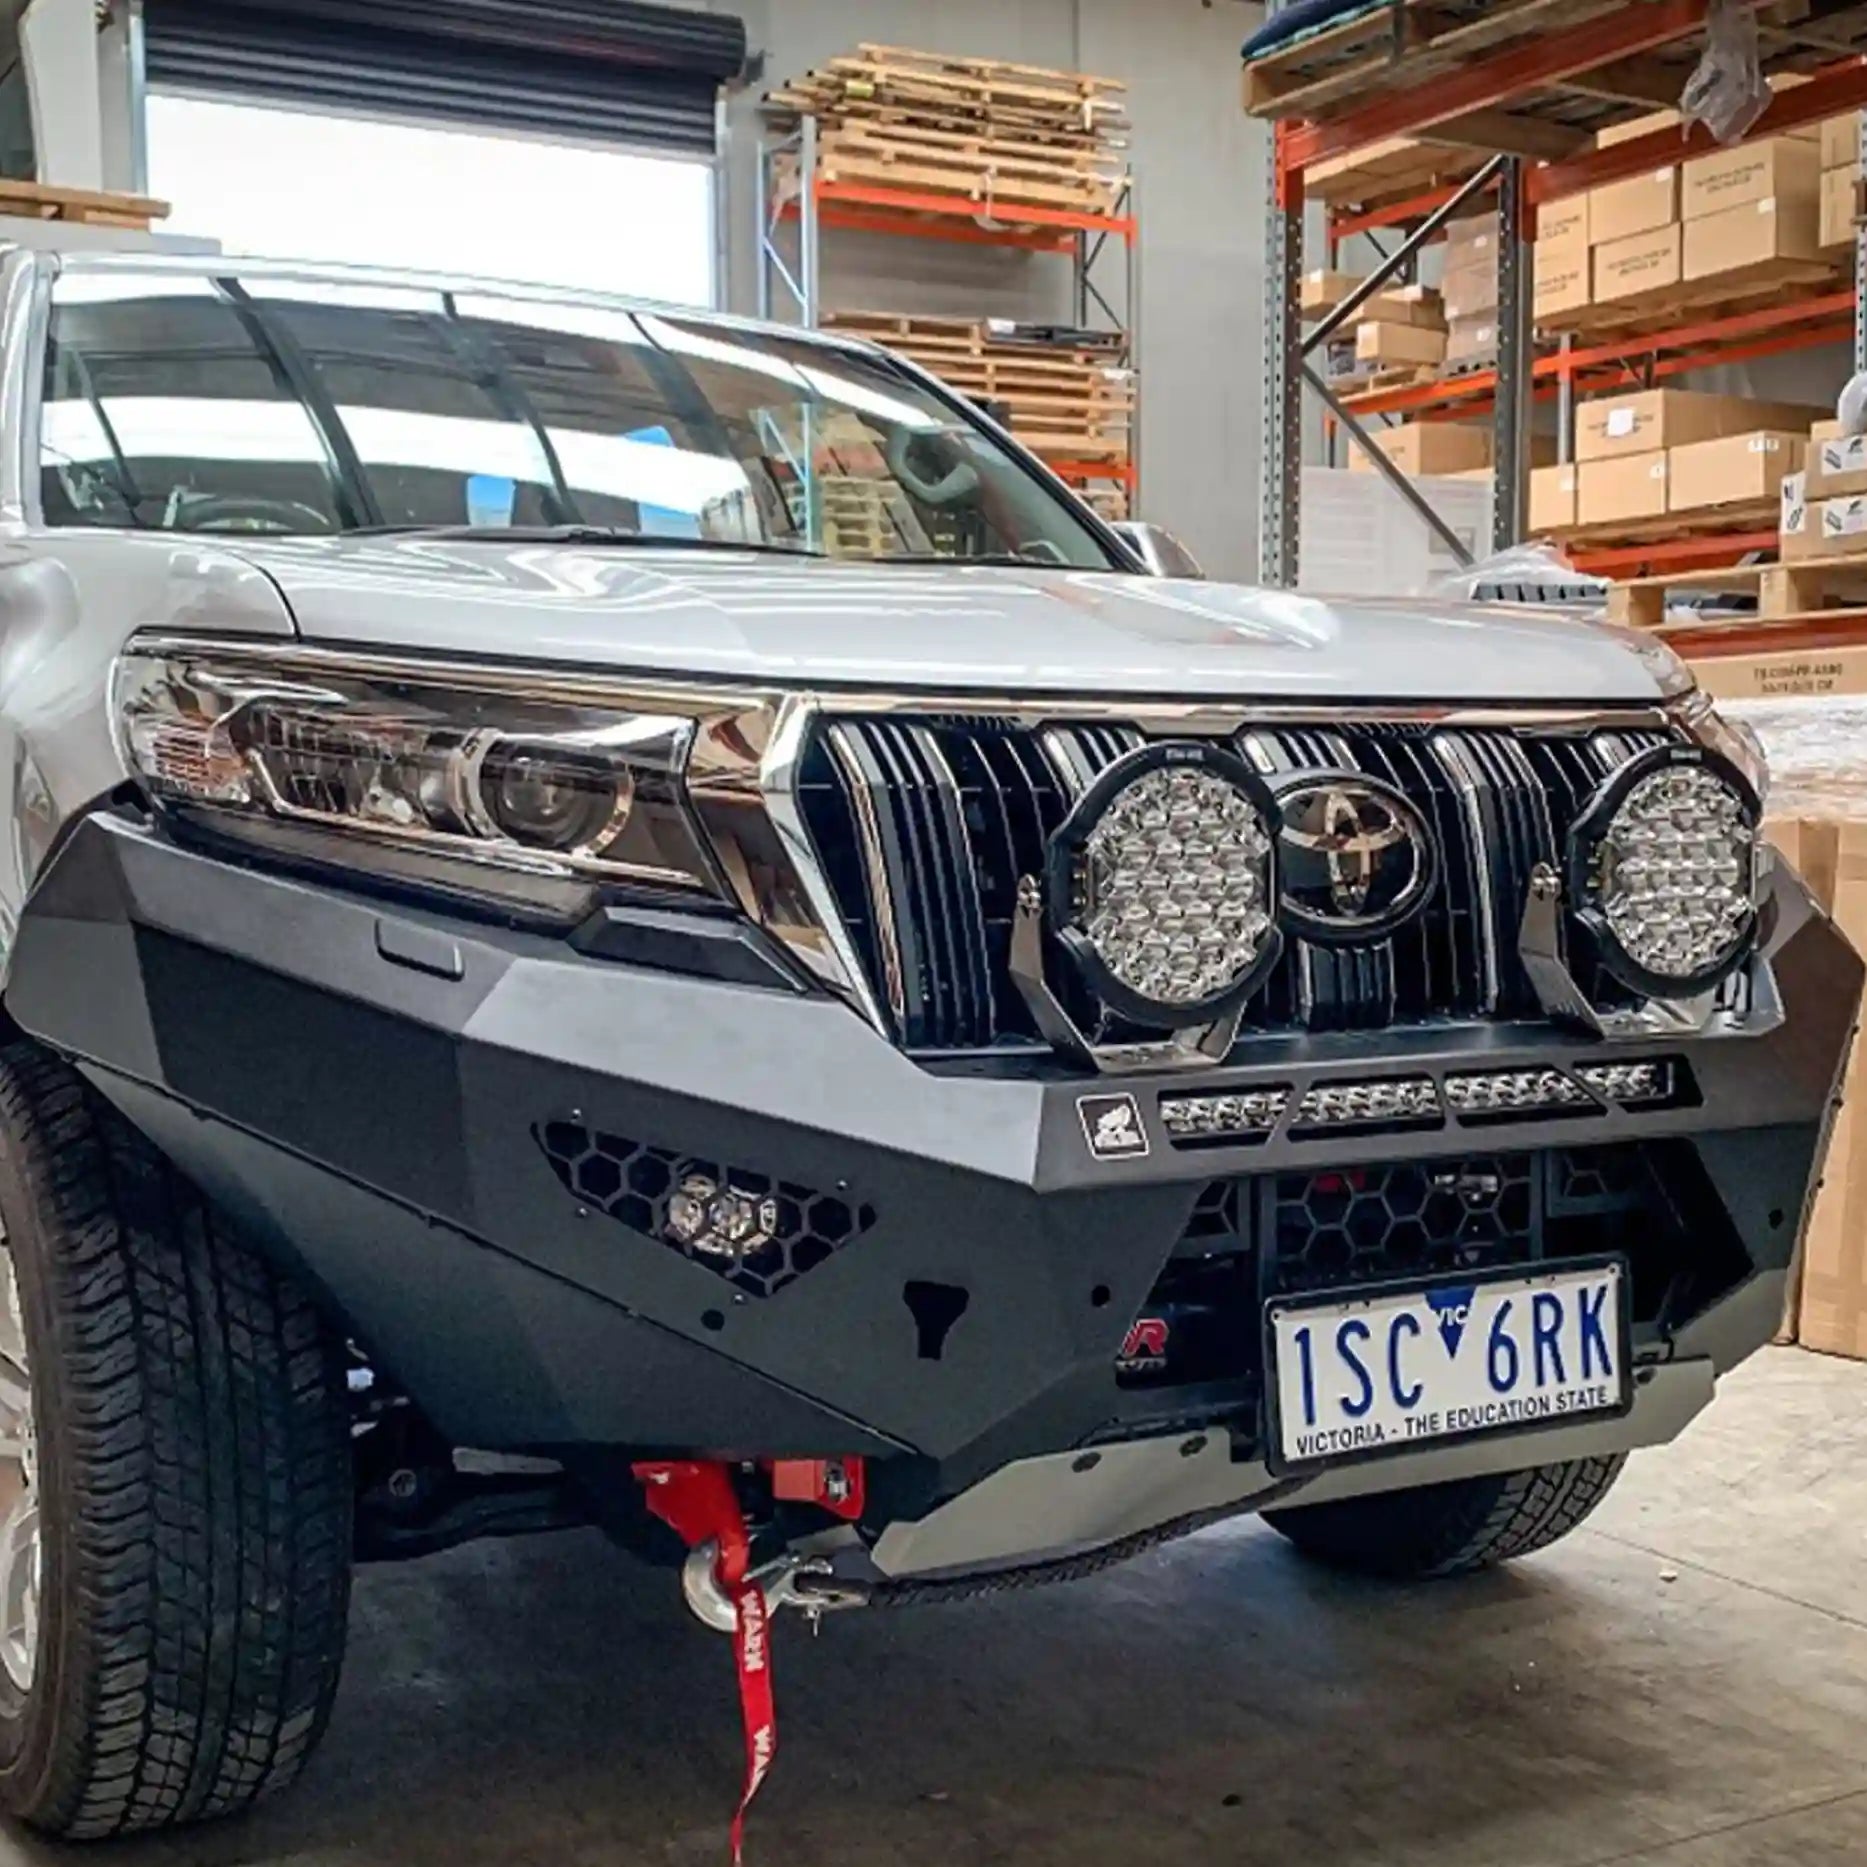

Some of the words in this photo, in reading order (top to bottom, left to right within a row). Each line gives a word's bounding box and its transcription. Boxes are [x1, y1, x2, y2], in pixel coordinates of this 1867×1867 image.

[1294, 1312, 1424, 1426] 1SC
[1487, 1284, 1613, 1393] 6RK
[1296, 1422, 1385, 1455] VICTORIA
[1404, 1412, 1440, 1437] THE
[1446, 1394, 1550, 1430] EDUCATION
[1556, 1385, 1607, 1411] STATE
[740, 1589, 765, 1673] WARN
